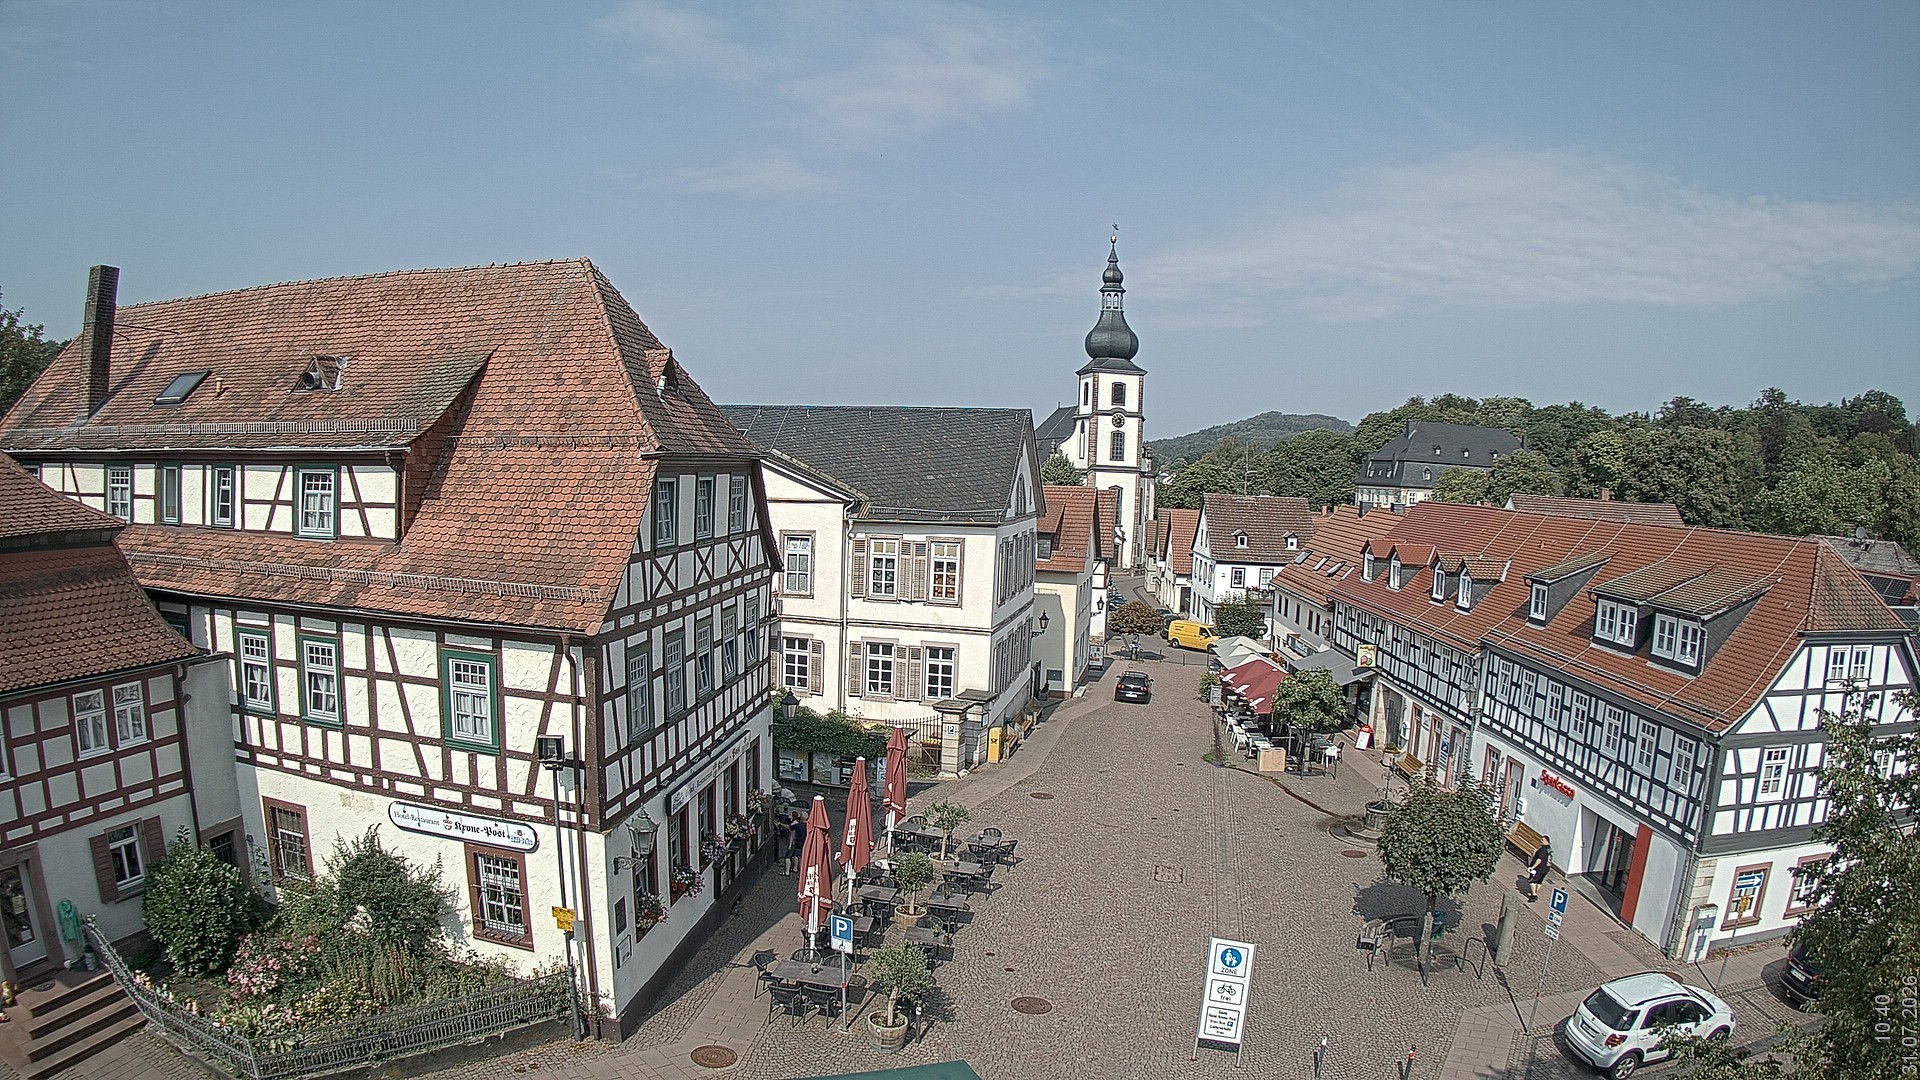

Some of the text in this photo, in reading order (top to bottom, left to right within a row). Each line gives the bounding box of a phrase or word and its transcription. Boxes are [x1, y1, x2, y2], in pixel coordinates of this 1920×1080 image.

[454, 821, 505, 838] Krone-Post
[1553, 891, 1565, 908] P
[836, 918, 848, 937] P
[1220, 966, 1238, 975] ZONE
[1220, 994, 1232, 1002] frei
